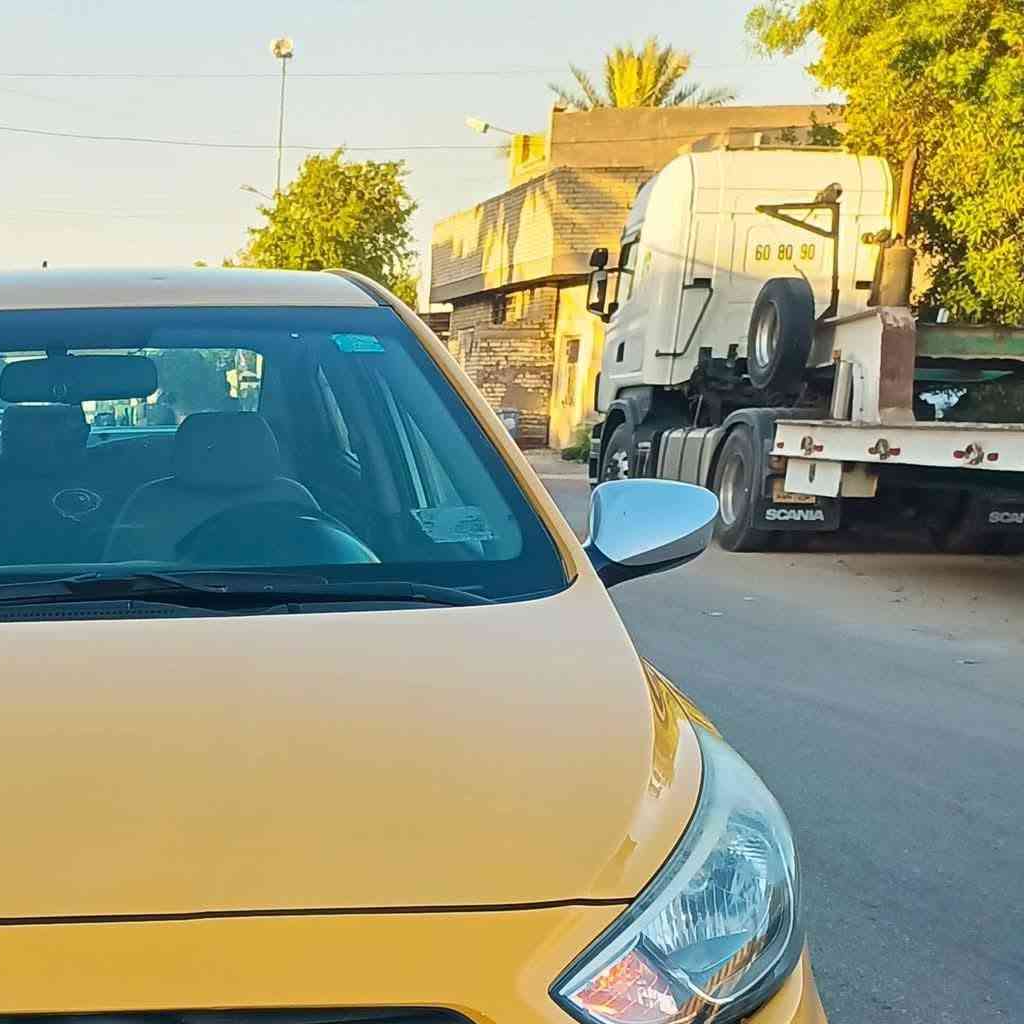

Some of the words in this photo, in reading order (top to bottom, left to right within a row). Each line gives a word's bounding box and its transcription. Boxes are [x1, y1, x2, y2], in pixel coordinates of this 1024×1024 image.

[755, 244, 770, 261] 60
[778, 243, 793, 260] 80
[800, 243, 815, 260] 90
[765, 508, 825, 521] SCANIA
